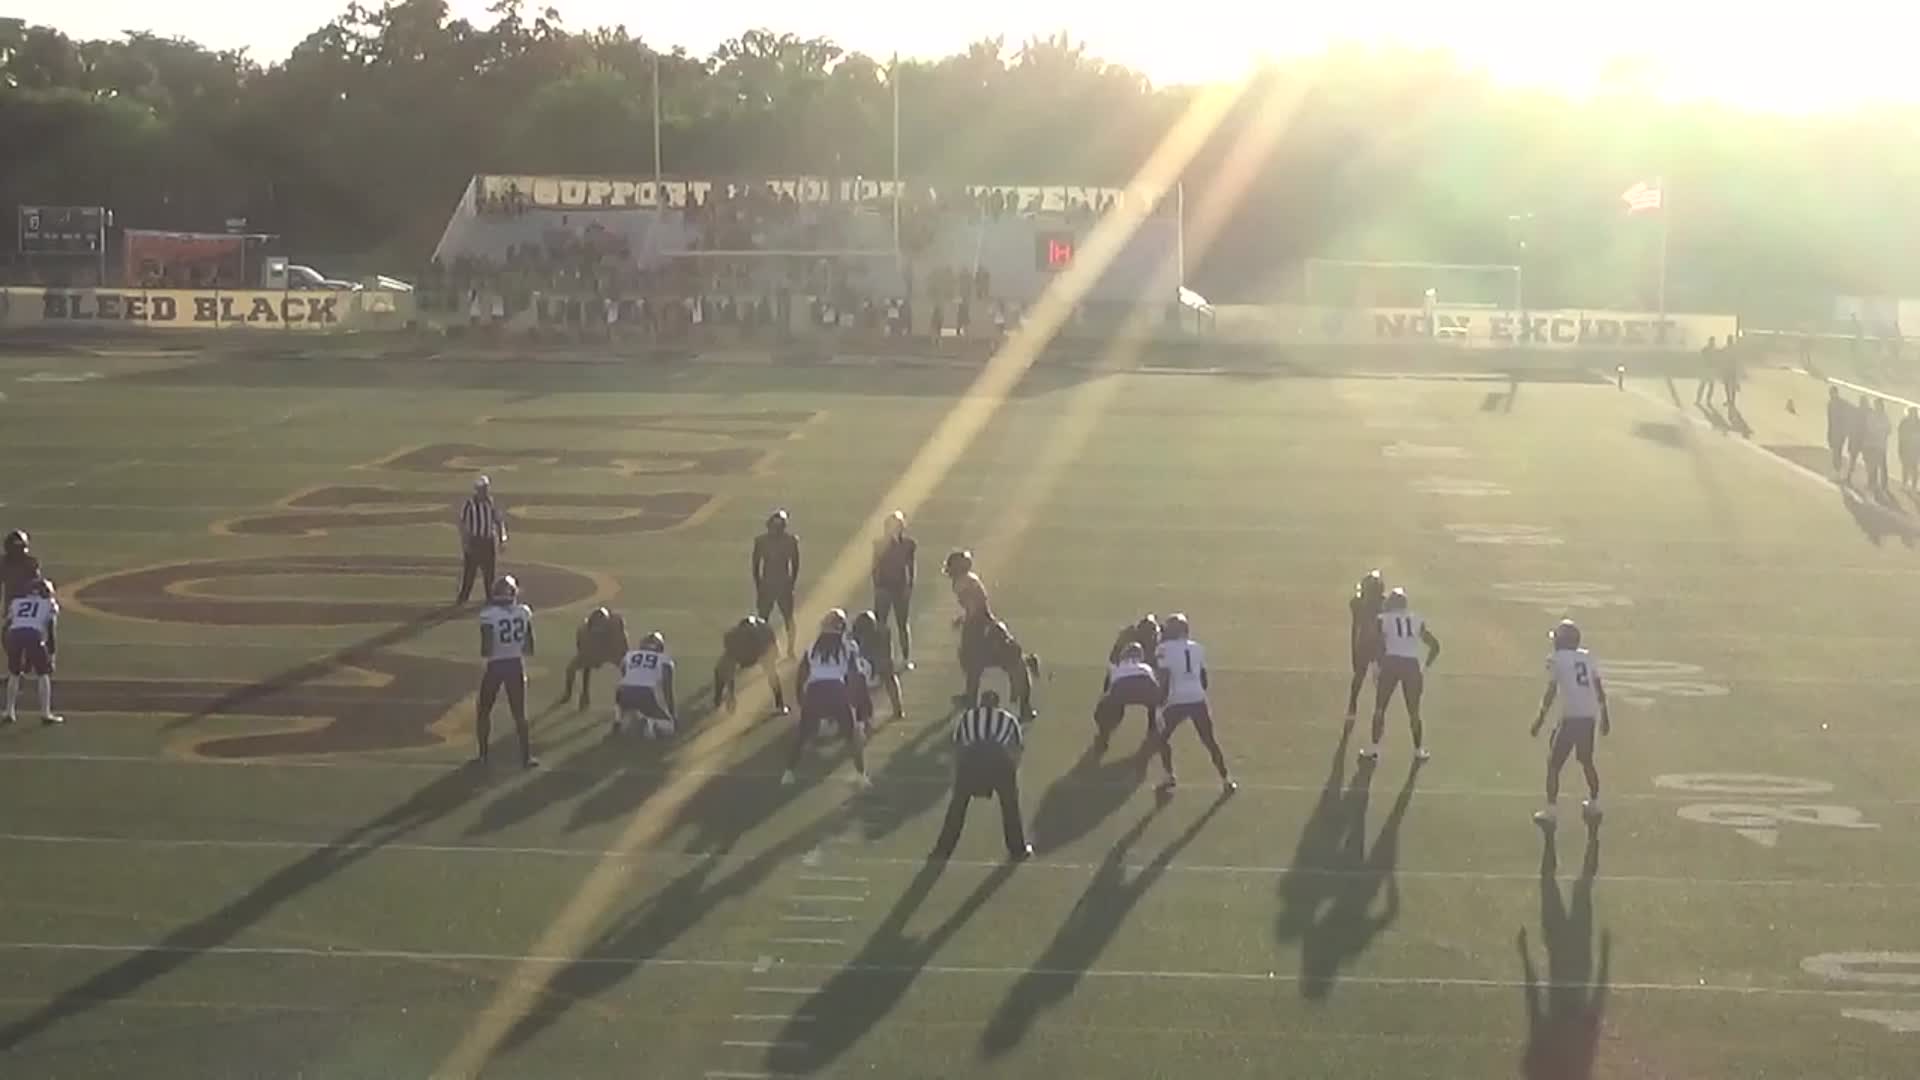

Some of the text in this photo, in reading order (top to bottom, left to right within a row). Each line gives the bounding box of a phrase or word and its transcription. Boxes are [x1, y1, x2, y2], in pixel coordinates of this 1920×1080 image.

[43, 294, 338, 323] BLEED BLACK
[17, 601, 40, 618] 21
[498, 616, 526, 645] 22
[1395, 616, 1413, 638] 11
[629, 653, 659, 670] 99
[1183, 648, 1192, 674] 1
[1574, 660, 1590, 689] 2
